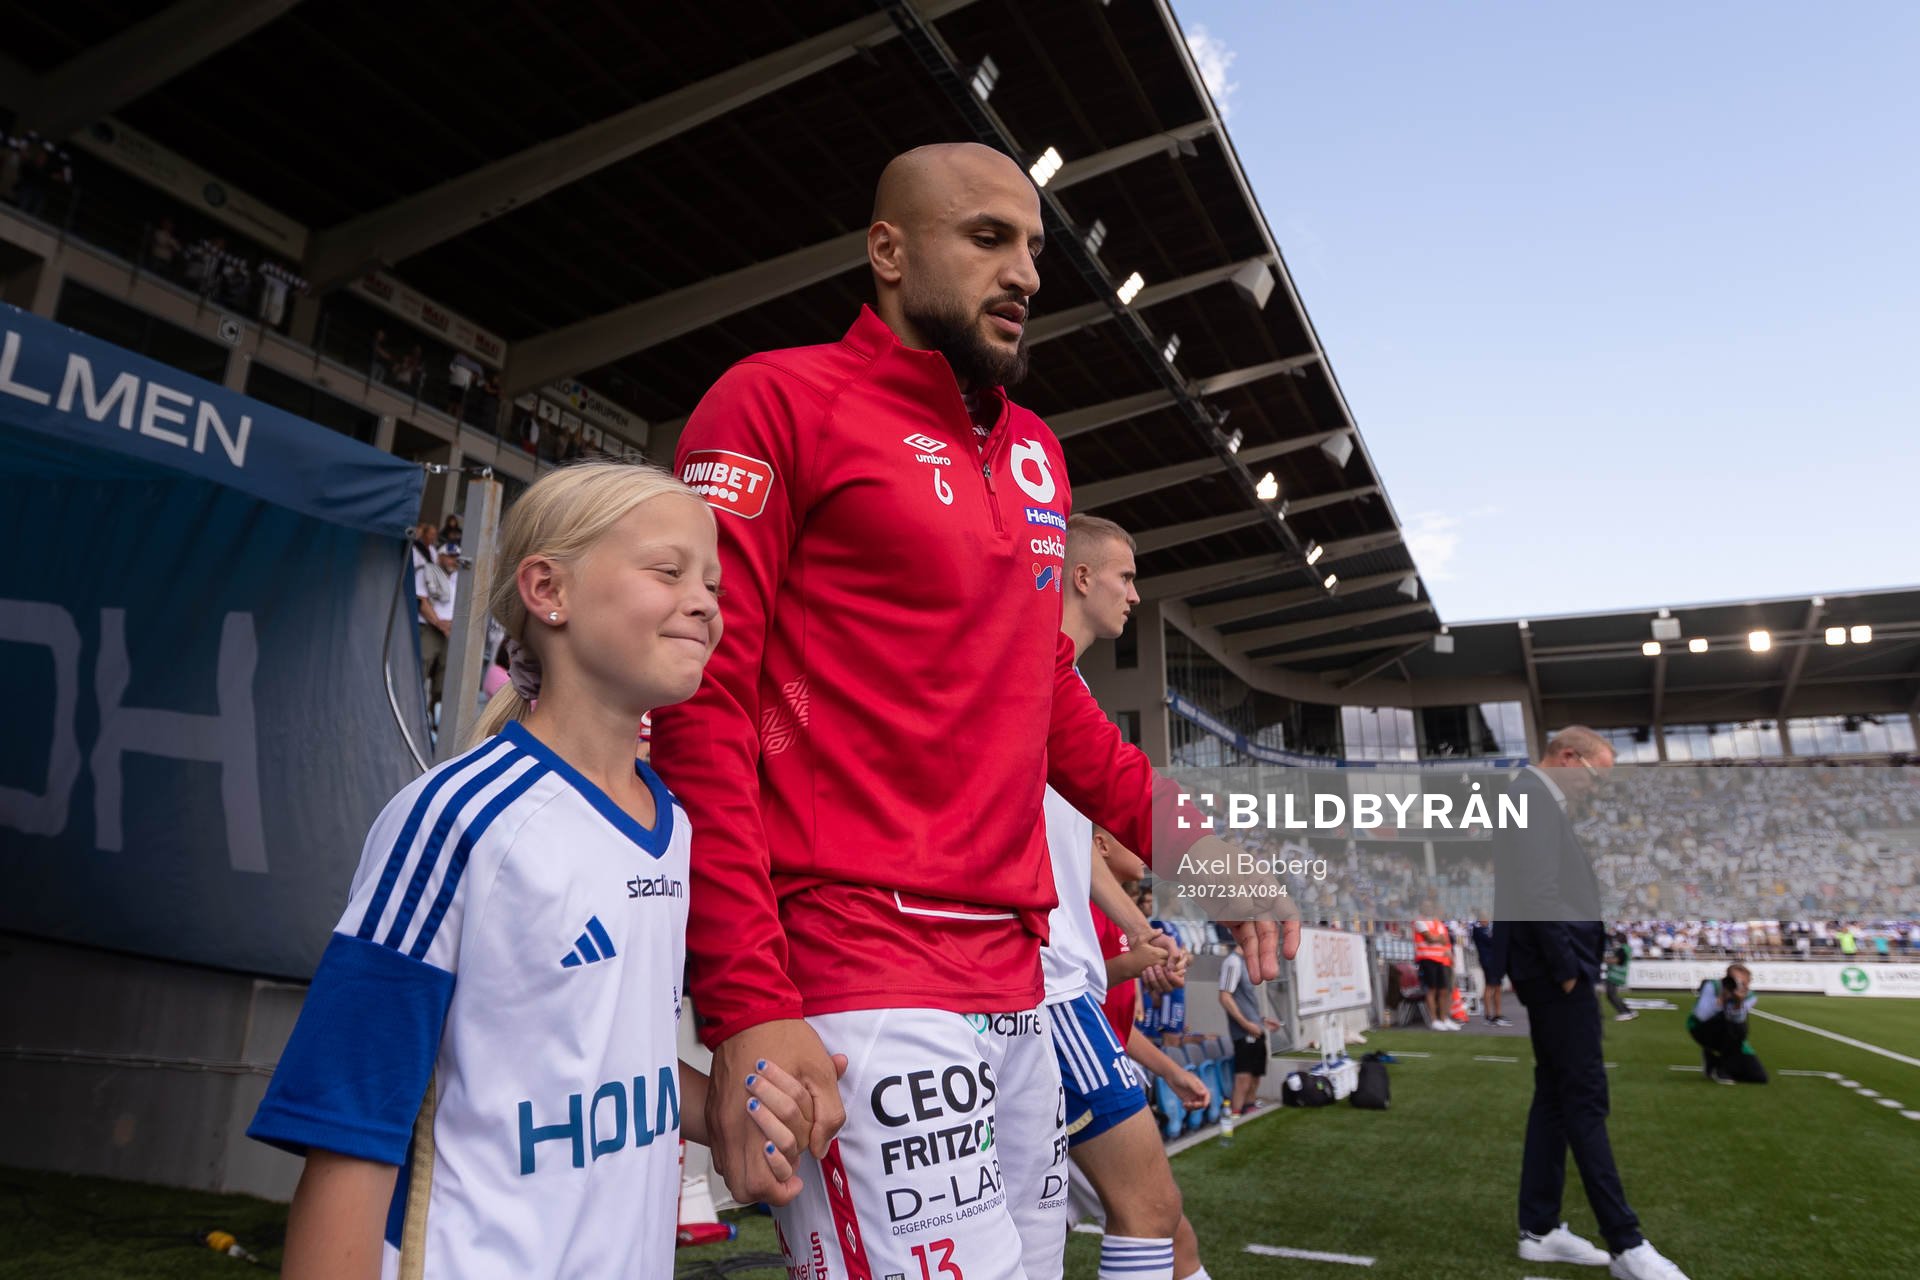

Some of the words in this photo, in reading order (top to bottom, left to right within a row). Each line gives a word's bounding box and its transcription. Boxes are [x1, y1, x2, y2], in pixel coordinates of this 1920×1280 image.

[915, 454, 951, 466] umbro
[683, 462, 763, 494] UNIBET
[934, 468, 954, 505] 6
[1026, 508, 1066, 531] Helmia
[627, 874, 683, 899] stadium
[1112, 1057, 1138, 1089] 19
[870, 1061, 996, 1128] CEOS
[886, 1159, 1001, 1222] D-LAB
[892, 1213, 954, 1236] DEGERFORS
[911, 1238, 964, 1280] 13
